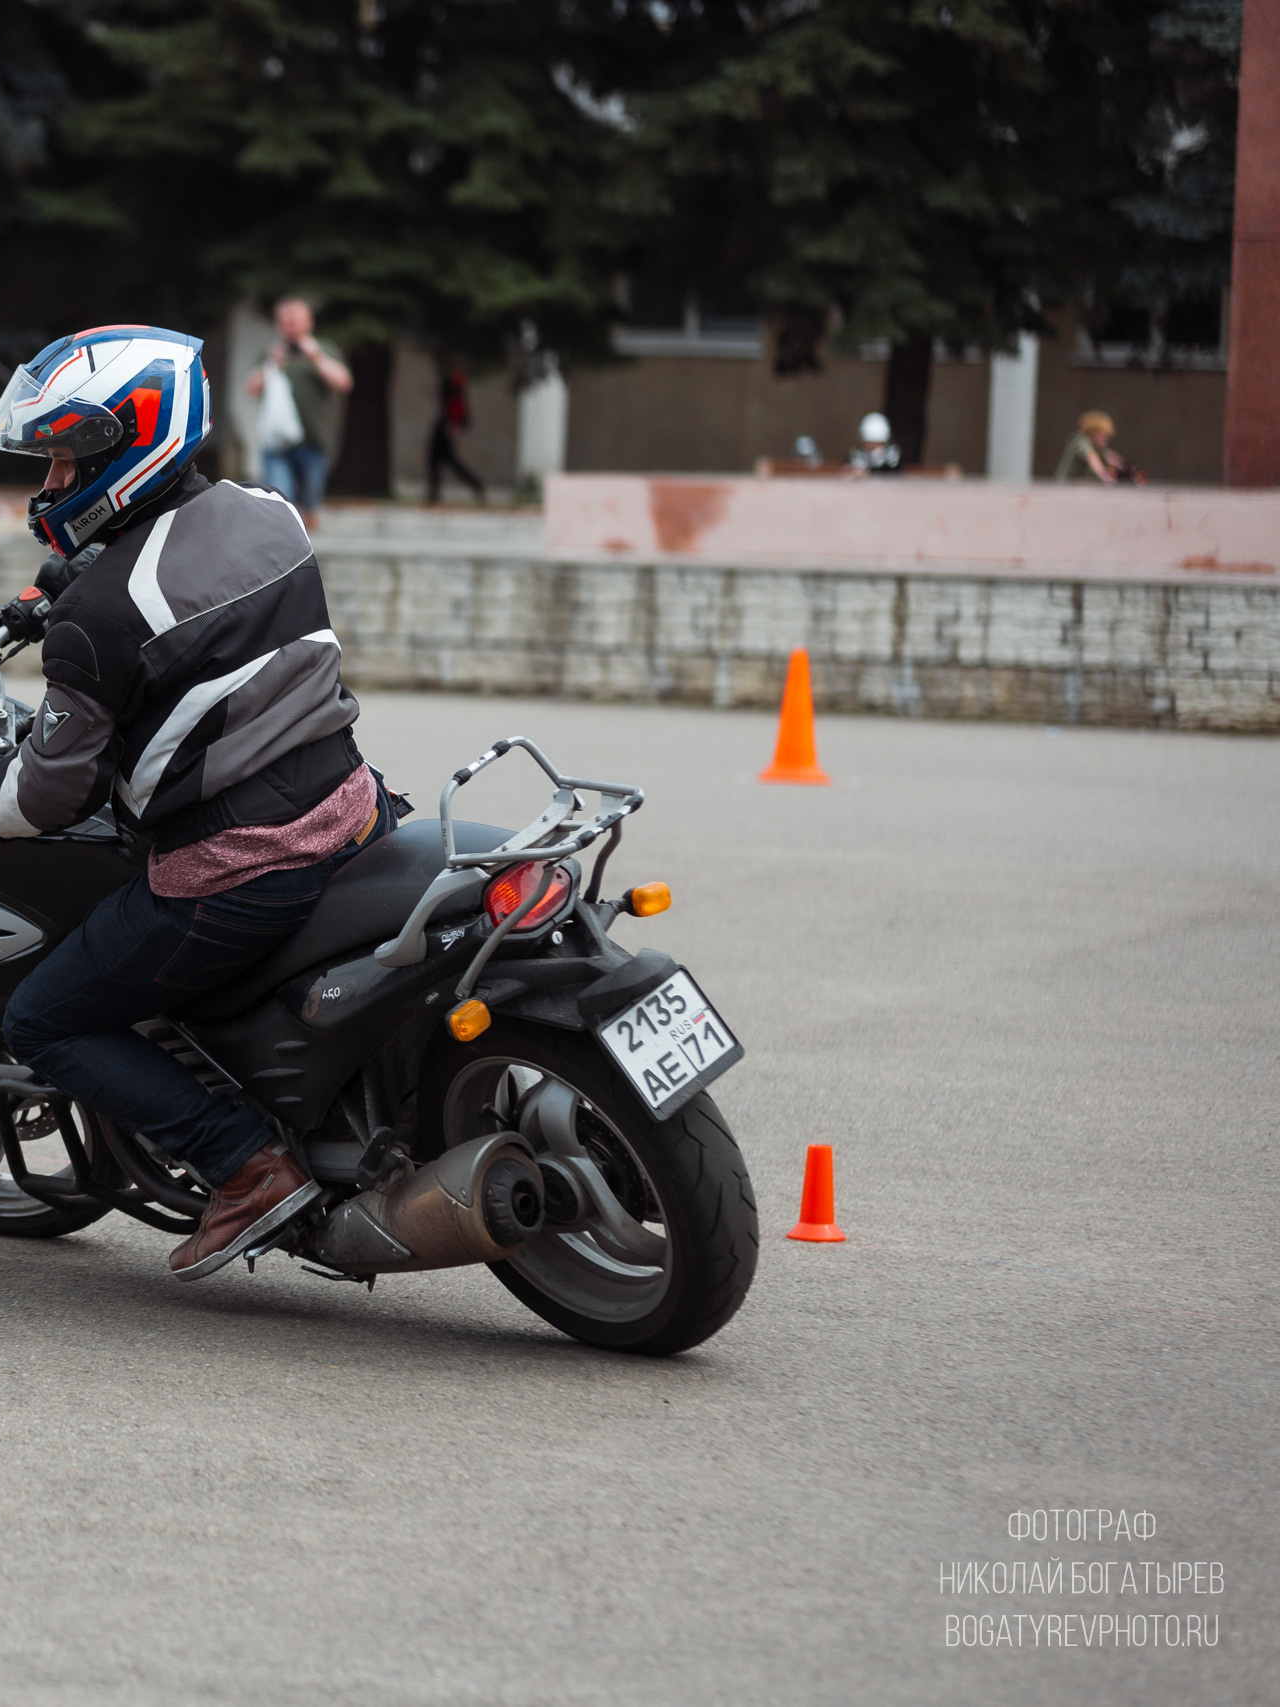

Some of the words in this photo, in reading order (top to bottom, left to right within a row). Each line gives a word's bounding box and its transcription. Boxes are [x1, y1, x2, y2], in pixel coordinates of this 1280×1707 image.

[71, 505, 107, 532] AIROH
[617, 983, 687, 1053] 2135
[670, 1019, 692, 1041] RUS
[682, 1021, 725, 1064] 71
